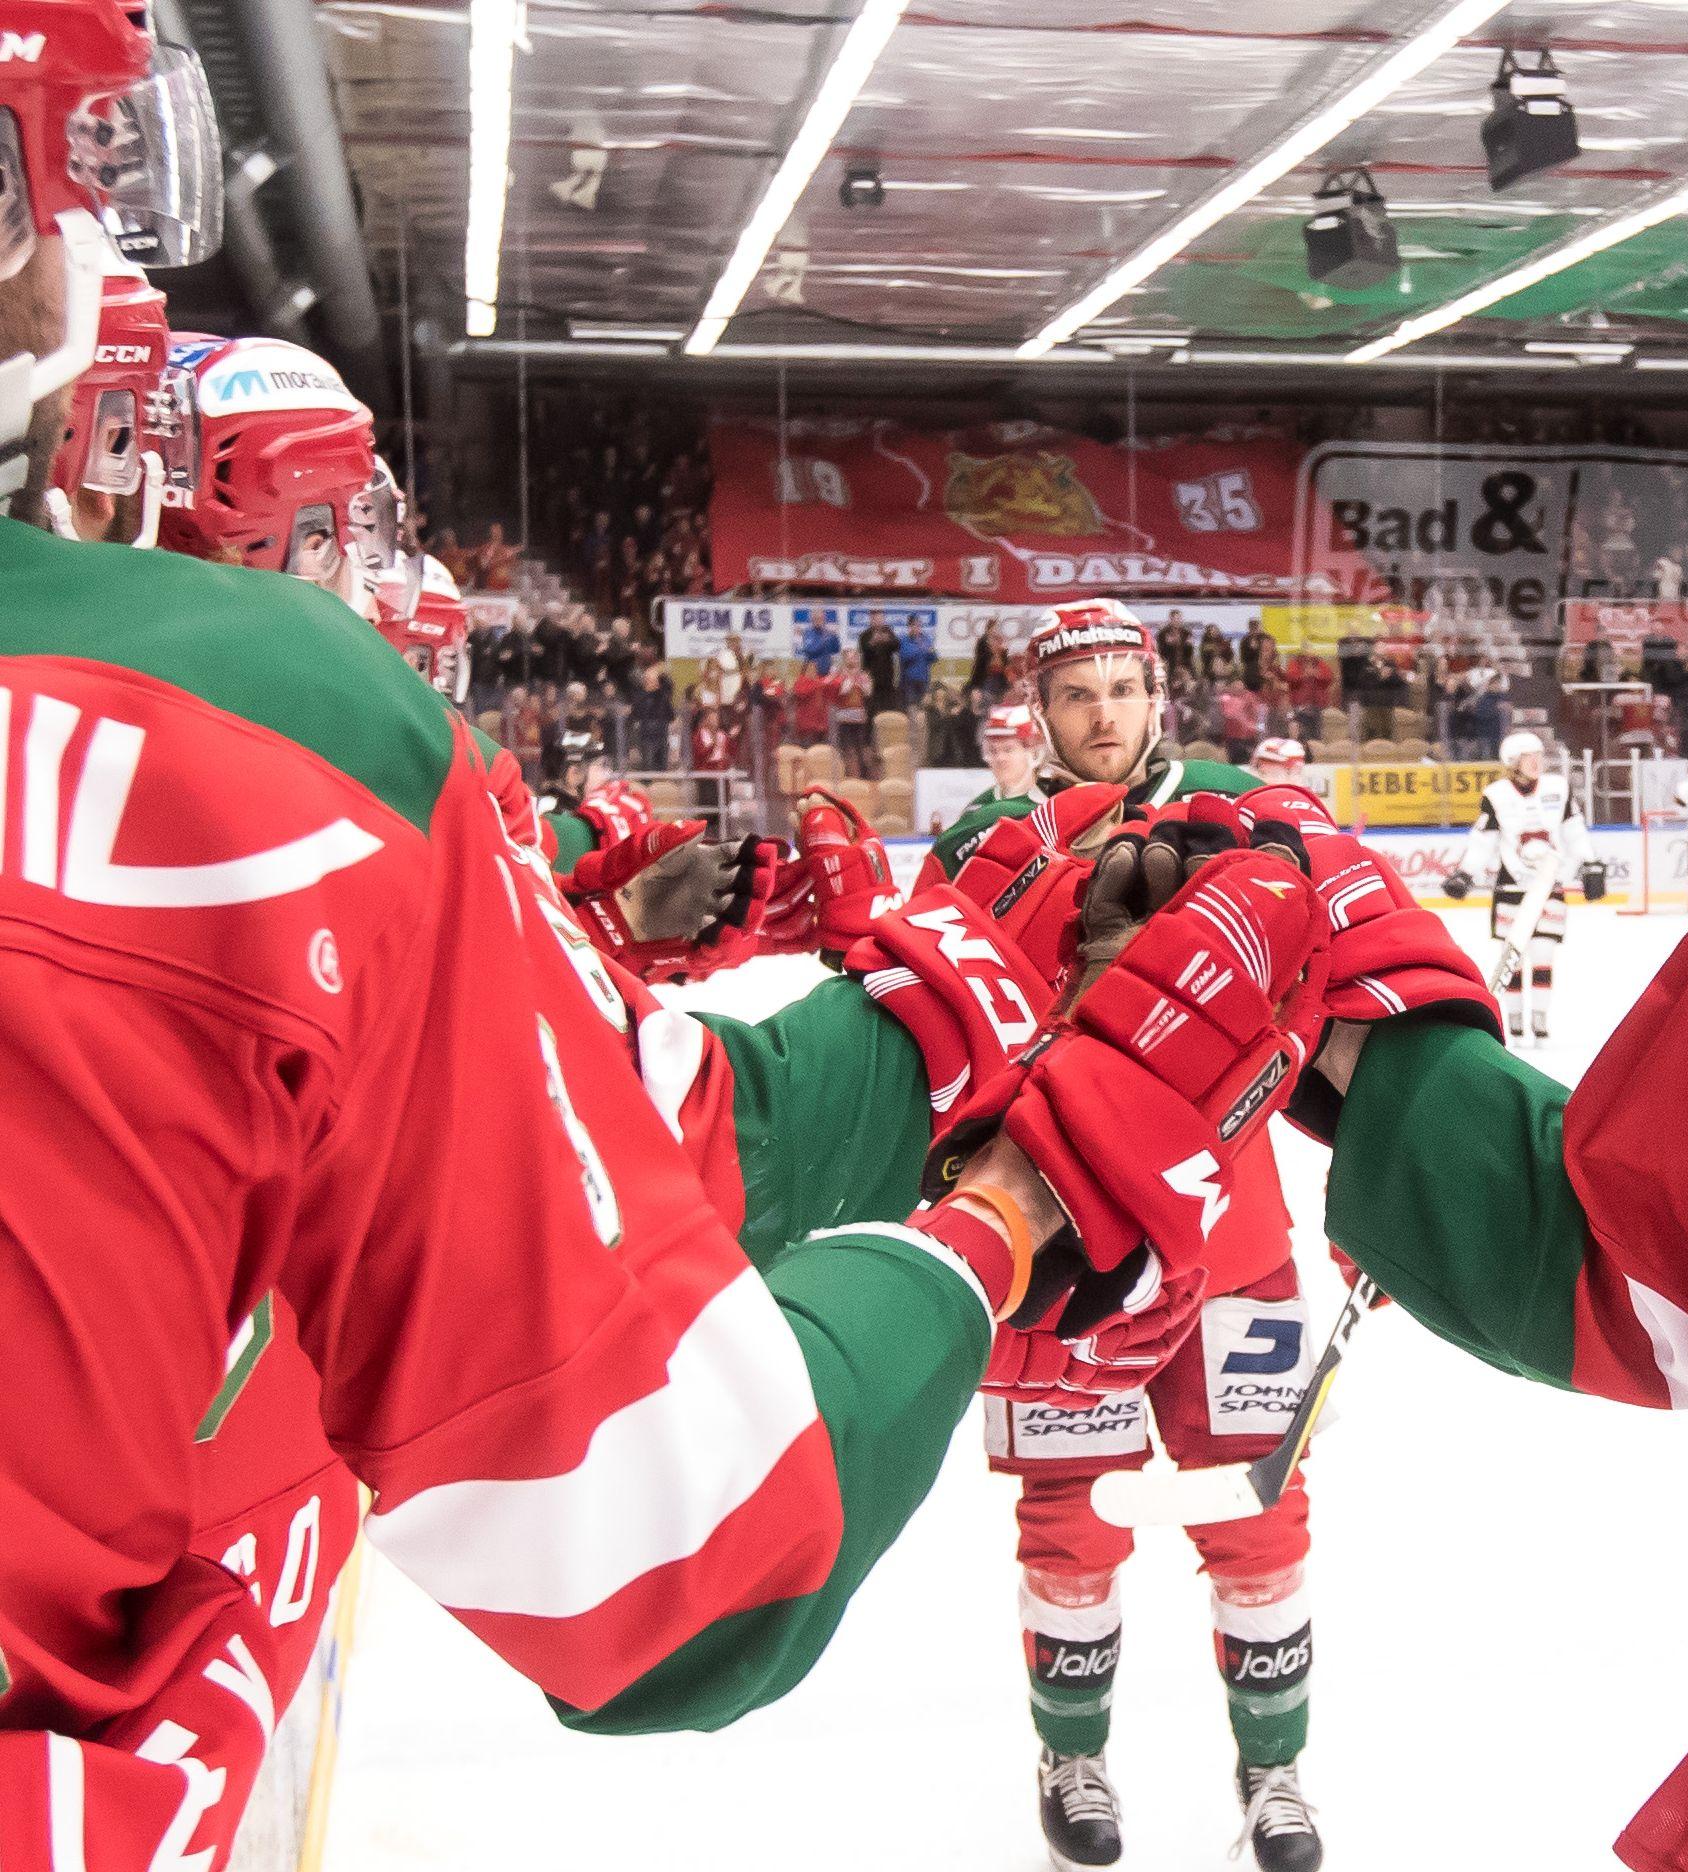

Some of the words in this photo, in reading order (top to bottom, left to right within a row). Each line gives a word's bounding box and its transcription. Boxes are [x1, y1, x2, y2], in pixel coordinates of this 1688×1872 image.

[1177, 473, 1260, 533] 35
[682, 608, 731, 632] PBM
[742, 608, 773, 632] AS
[1215, 1383, 1306, 1400] JOHN
[1019, 1401, 1141, 1421] JOHNS
[1021, 1417, 1141, 1437] SPORT
